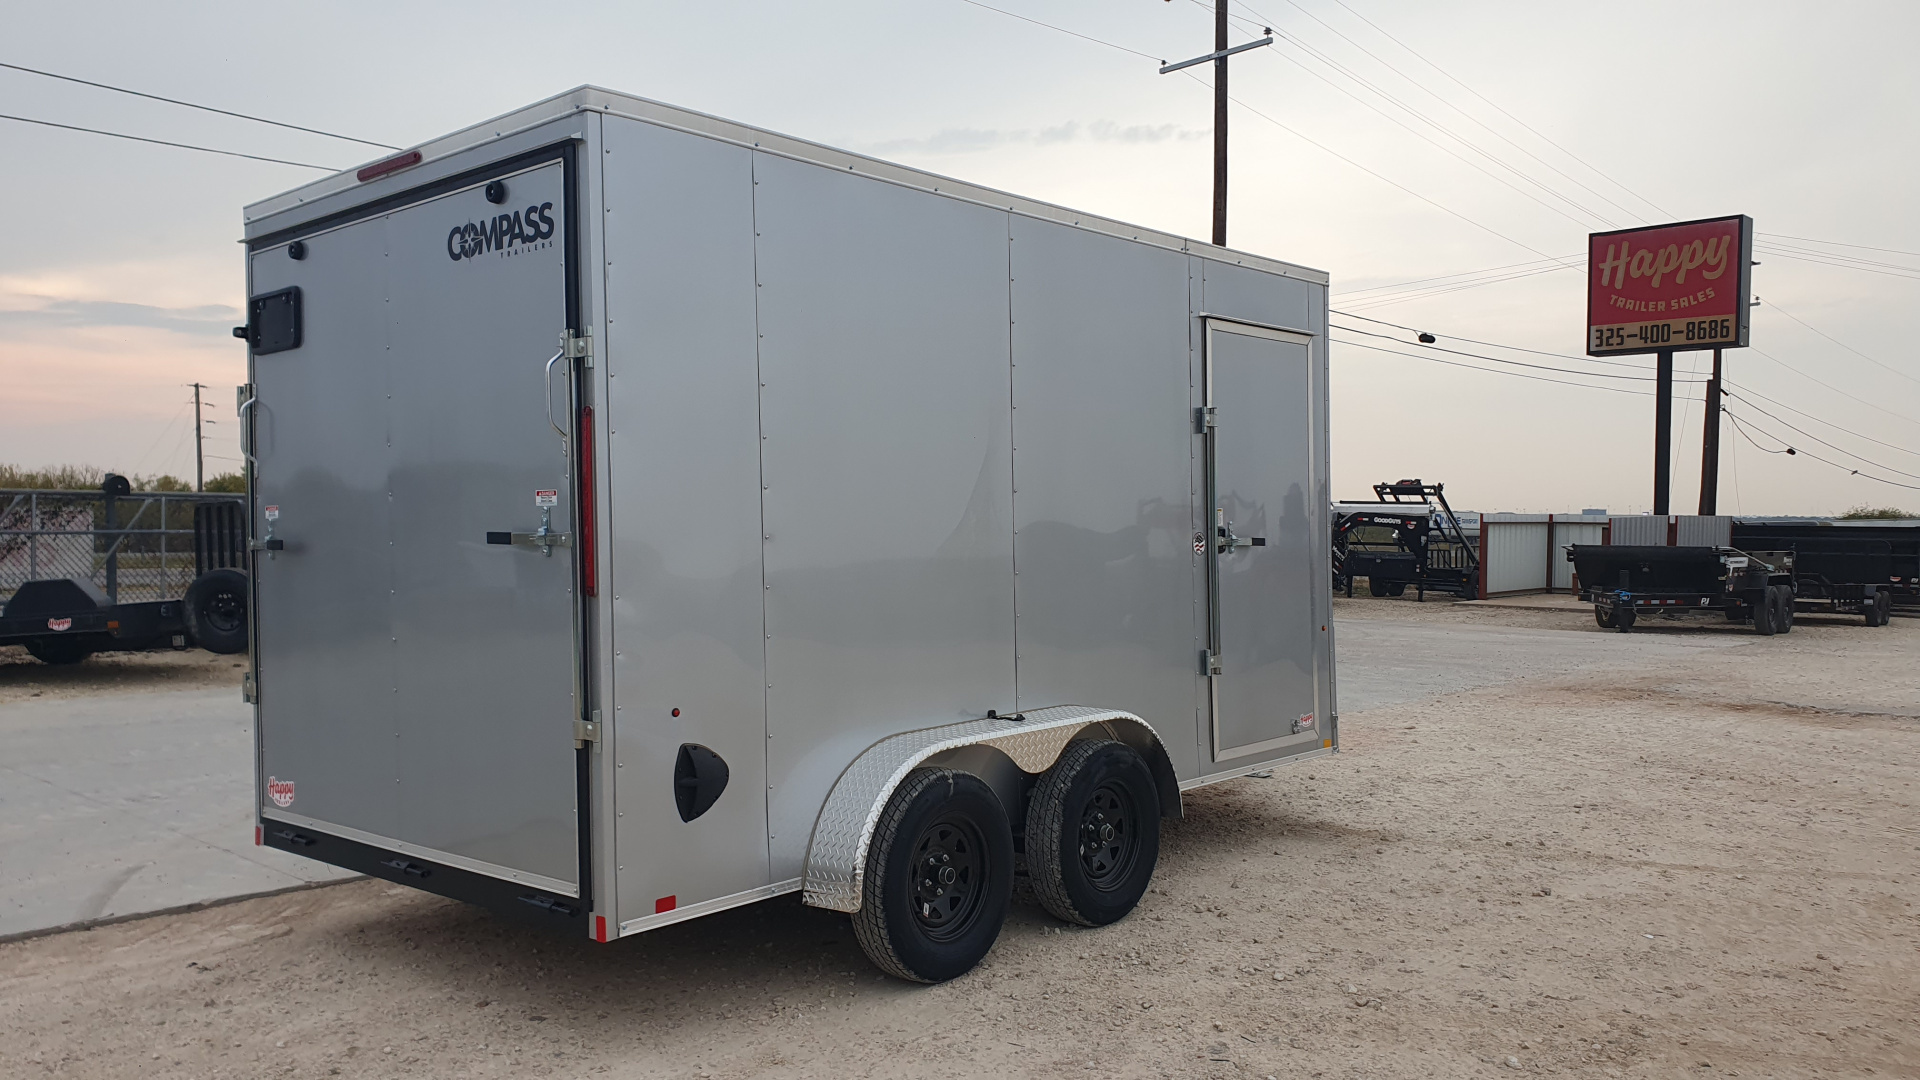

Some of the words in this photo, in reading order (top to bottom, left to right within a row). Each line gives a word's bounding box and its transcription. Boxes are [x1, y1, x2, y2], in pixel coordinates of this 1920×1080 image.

[447, 202, 554, 261] COMPASS
[500, 241, 553, 259] TRAILERS
[1599, 235, 1731, 289] Happy
[1609, 294, 1666, 312] TRAILER
[1671, 287, 1715, 310] SALES
[1595, 319, 1730, 348] 325-400-8686
[1700, 597, 1710, 605] PJ
[269, 778, 294, 800] Happy
